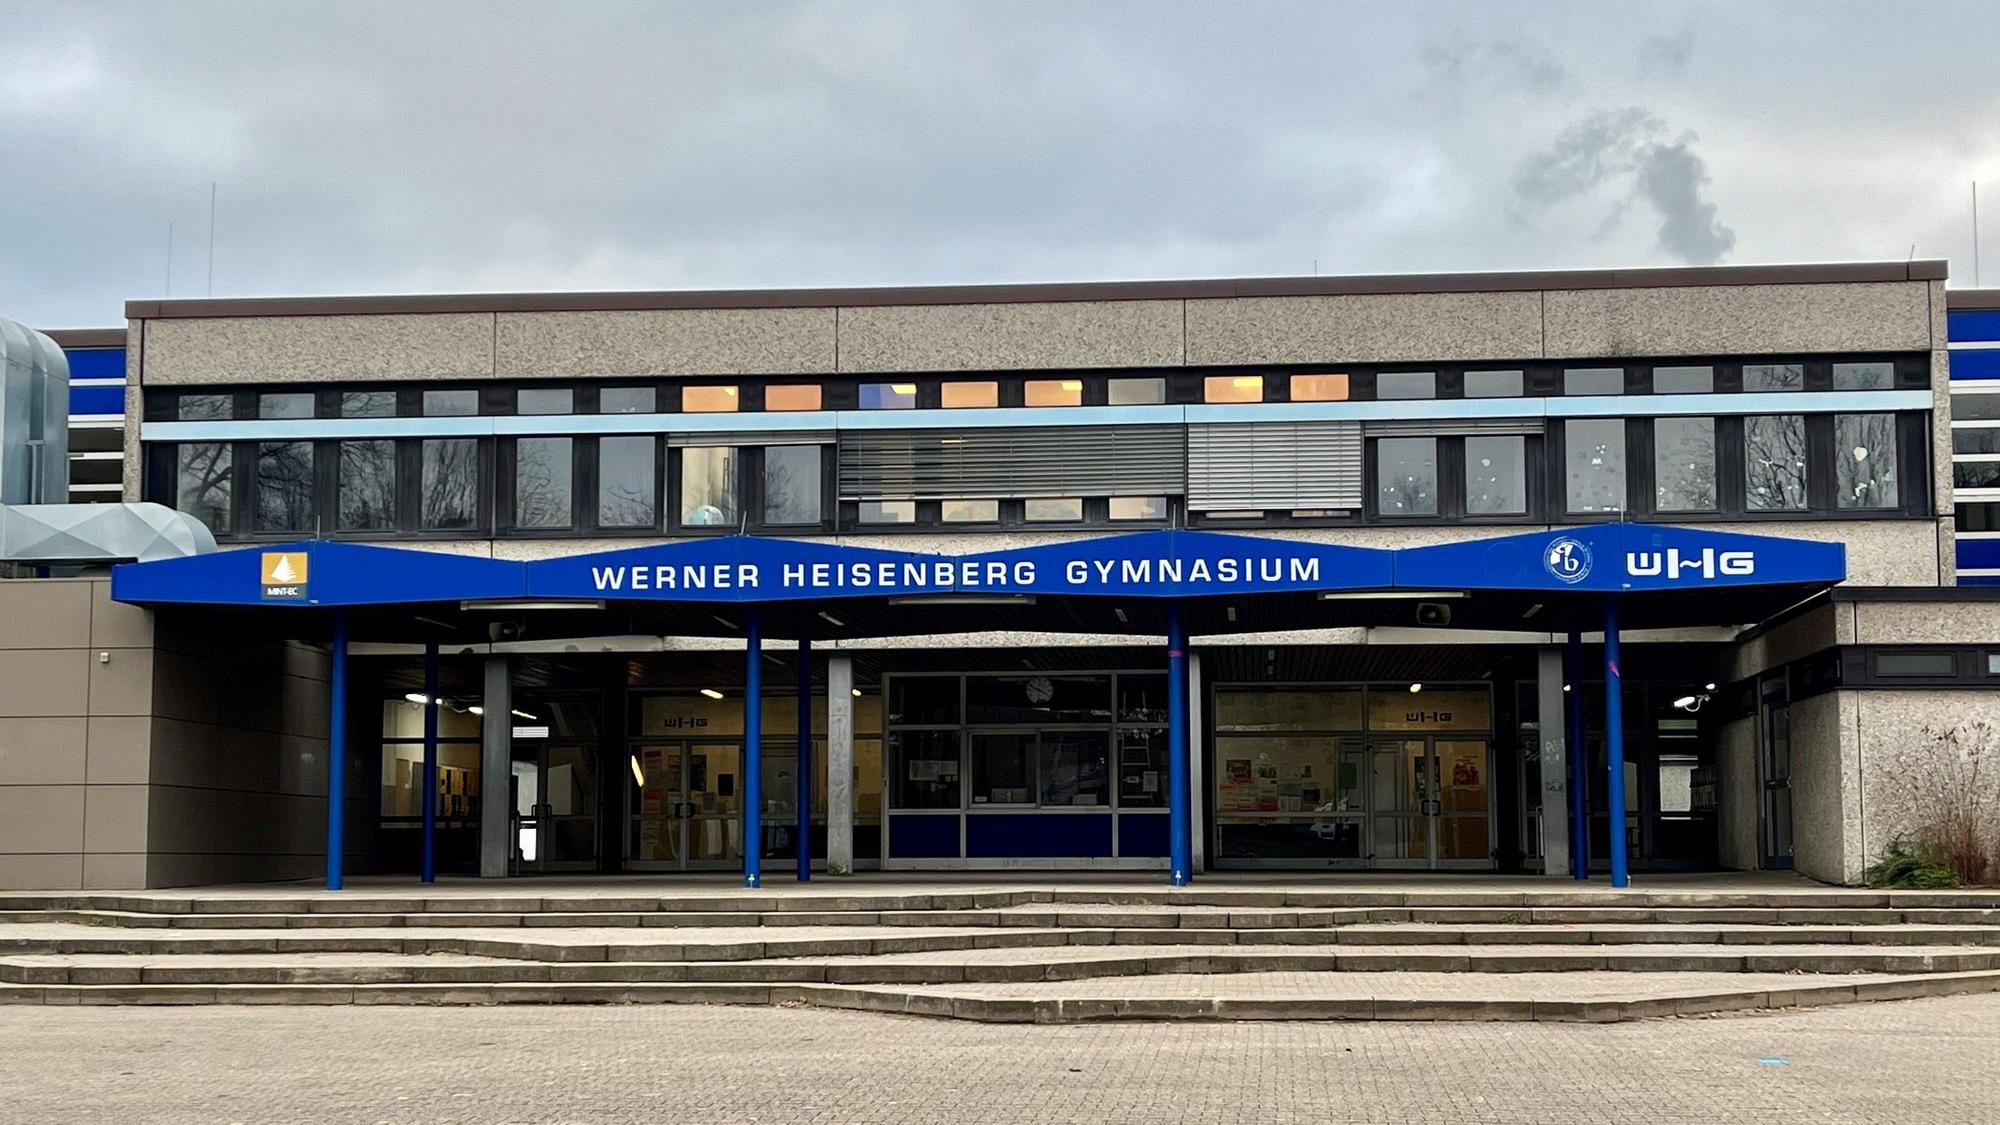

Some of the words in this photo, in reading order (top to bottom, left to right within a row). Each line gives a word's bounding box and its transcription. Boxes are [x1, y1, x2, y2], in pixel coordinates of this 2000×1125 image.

[592, 565, 758, 589] WERNER
[783, 562, 1035, 587] HEISENBERG
[1066, 558, 1319, 584] GYMNASIUM
